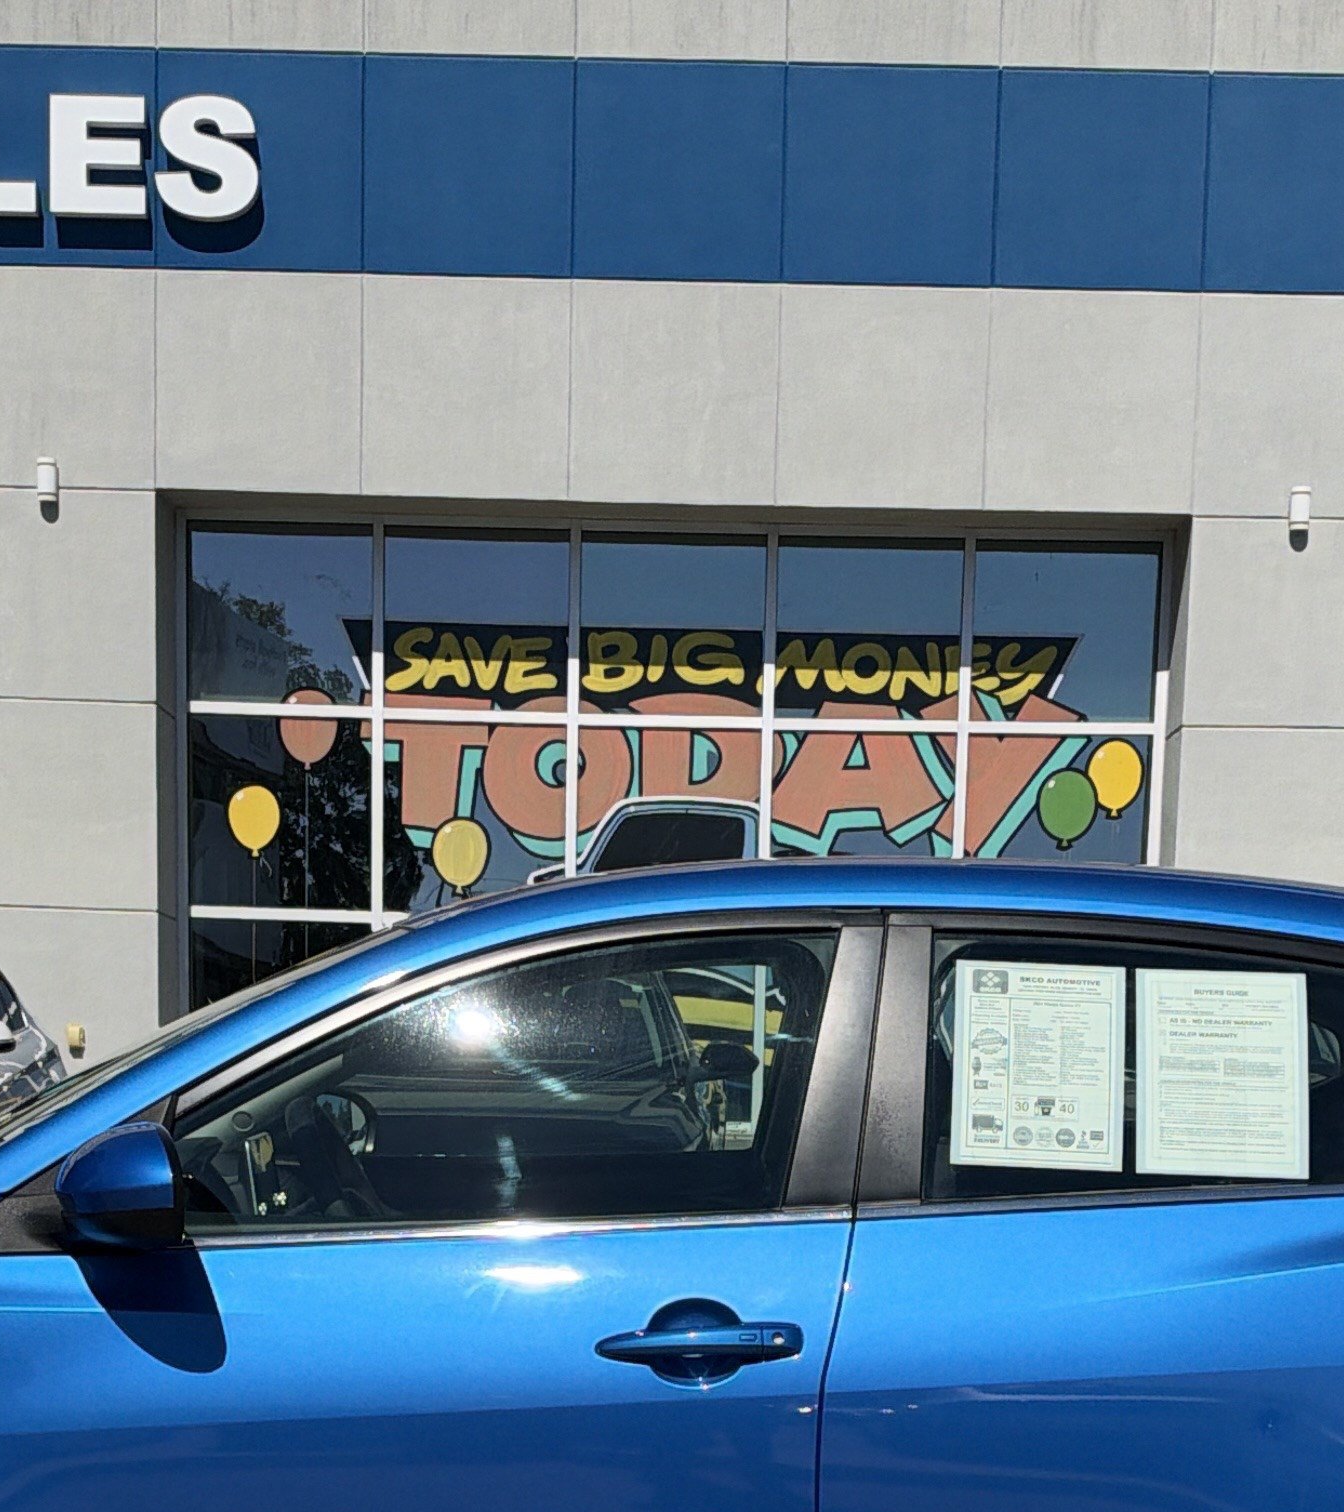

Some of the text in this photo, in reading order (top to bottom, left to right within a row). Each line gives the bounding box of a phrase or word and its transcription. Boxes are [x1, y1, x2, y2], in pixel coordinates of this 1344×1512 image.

[385, 627, 1057, 706] SAVE BIG MONEY
[360, 692, 1089, 860] TODAY
[1046, 978, 1102, 987] AUTOMOTIVE
[1014, 1101, 1030, 1113] 30
[1059, 1103, 1075, 1115] 40
